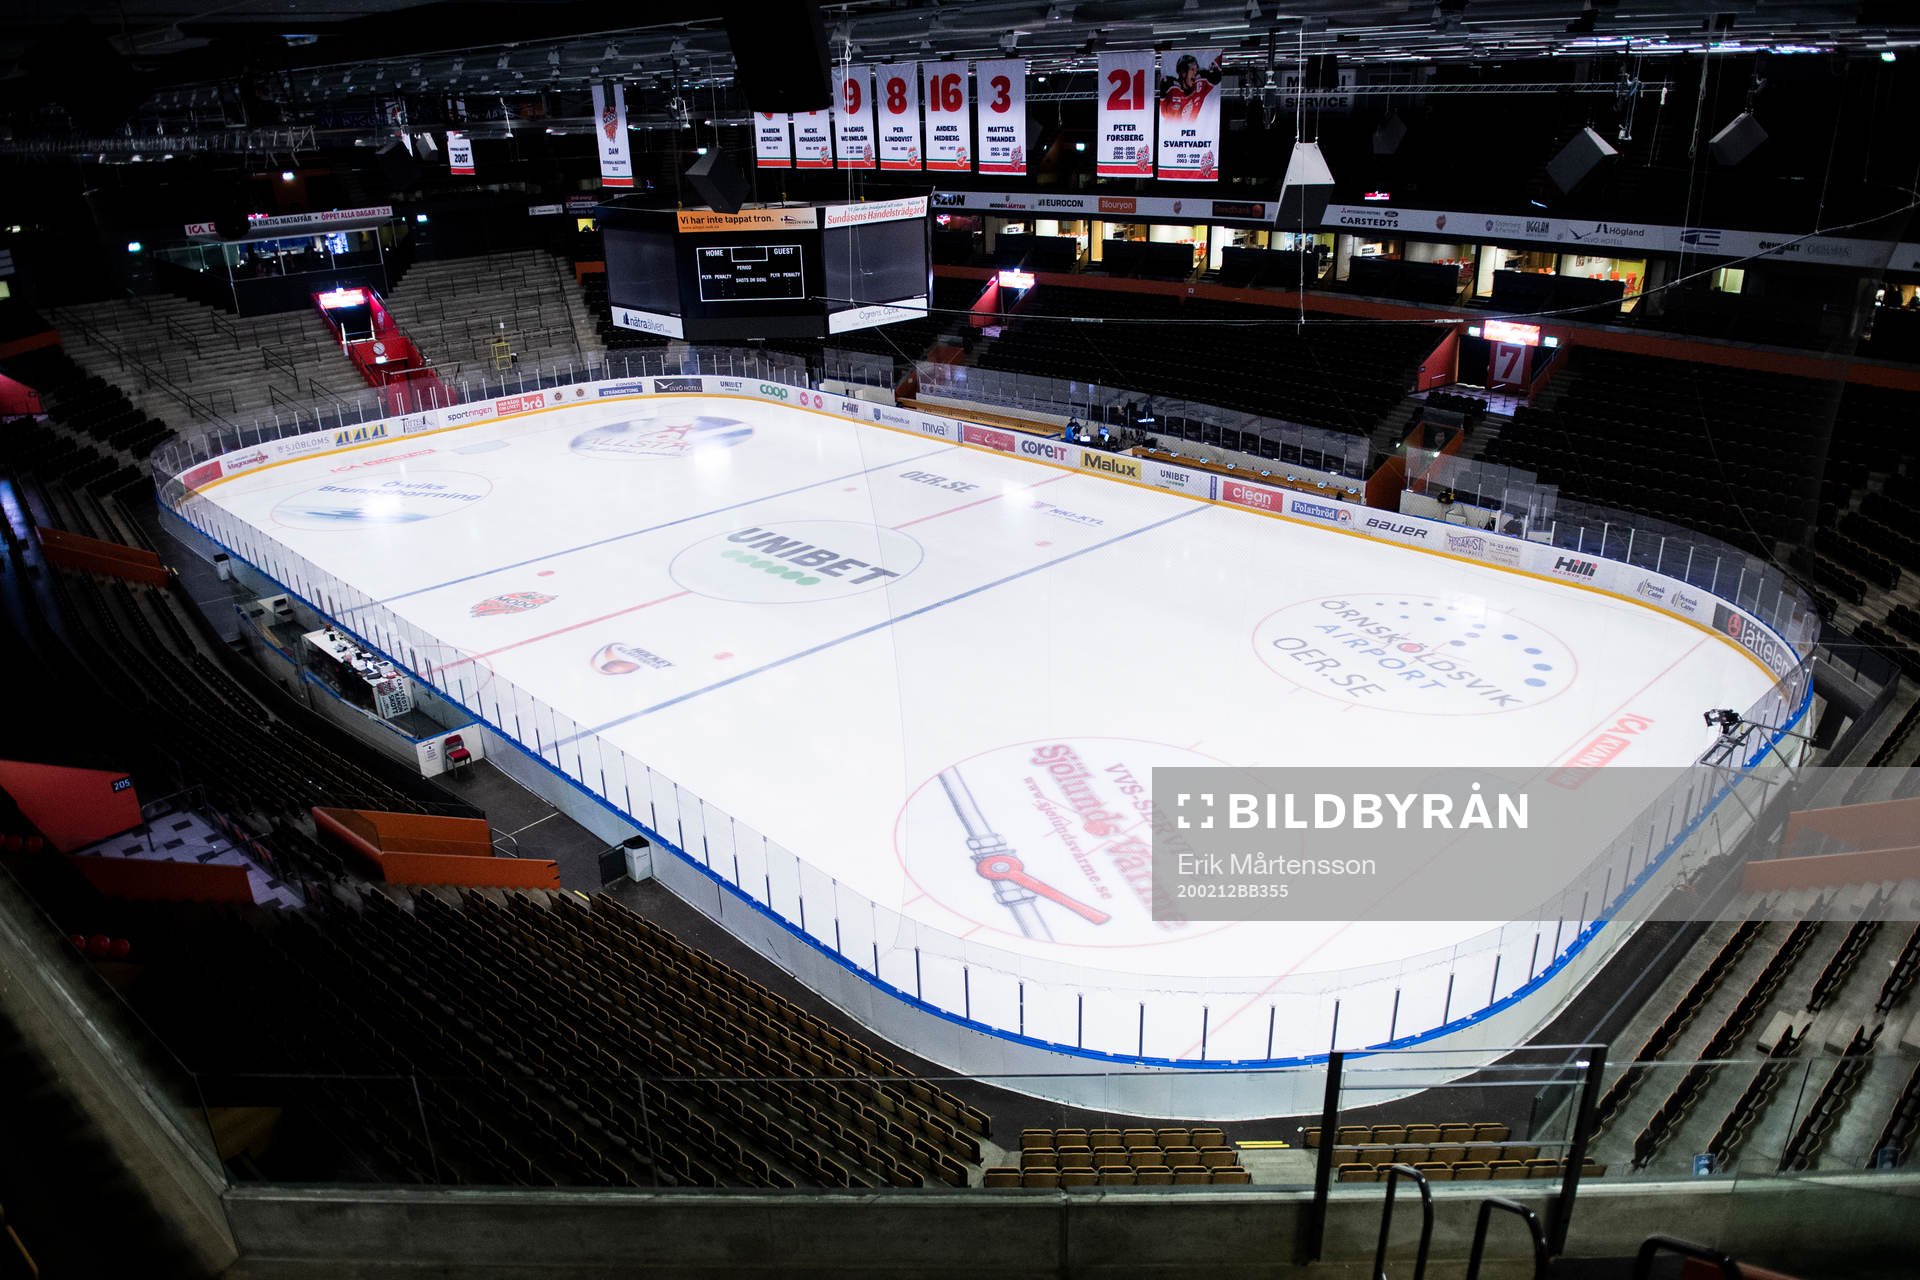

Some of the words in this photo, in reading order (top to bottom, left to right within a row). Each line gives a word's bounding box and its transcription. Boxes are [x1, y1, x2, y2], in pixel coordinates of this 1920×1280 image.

[843, 76, 861, 114] 9
[887, 77, 907, 115] 8
[930, 73, 963, 112] 16
[990, 75, 1011, 113] 3
[1107, 69, 1145, 110] 21
[1163, 140, 1212, 148] SVARTVADET
[455, 153, 468, 163] 2007
[1046, 199, 1084, 207] EUROCON
[1101, 200, 1133, 211] Nouryon
[258, 218, 280, 226] RIKTIG
[280, 215, 312, 224] MATAFFÄR
[321, 211, 341, 221] ÖPPET
[340, 210, 355, 219] ALLA
[355, 209, 376, 218] DAGAR
[680, 216, 690, 225] Vi
[690, 216, 705, 224] har
[706, 215, 723, 224] inte
[724, 215, 752, 225] tappat
[753, 215, 774, 223] tron.
[1340, 216, 1399, 228] CARSTEDTS
[188, 225, 205, 234] ICA
[1609, 226, 1645, 237] Högland
[705, 249, 724, 257] HOME
[1500, 345, 1521, 378] 7
[760, 384, 788, 400] coop
[447, 407, 493, 422] sportringen
[922, 421, 945, 436] miva
[1021, 440, 1067, 461] coreIT
[1084, 453, 1137, 477] Malux
[899, 470, 980, 494] OER.SE
[1160, 469, 1190, 483] UNIBET
[382, 481, 448, 491] Öviks
[1232, 486, 1272, 505] clean
[1294, 501, 1335, 519] Polarbröd
[1366, 518, 1428, 539] BAUER
[727, 527, 900, 585] UNIBET
[1554, 556, 1598, 577] Hilli
[1646, 582, 1665, 594] Svensk
[1647, 589, 1663, 600] Cater
[1679, 594, 1697, 606] Svensk
[1680, 602, 1695, 613] Cater
[1314, 622, 1448, 691] AIRPORT
[1319, 599, 1524, 707] ÖRNSKÖLDSVIK
[1272, 637, 1387, 698] OER.SE
[396, 678, 409, 711] CARSTEDTS
[388, 694, 399, 714] SKOTT
[1605, 712, 1657, 735] ICA
[114, 778, 131, 791] 205
